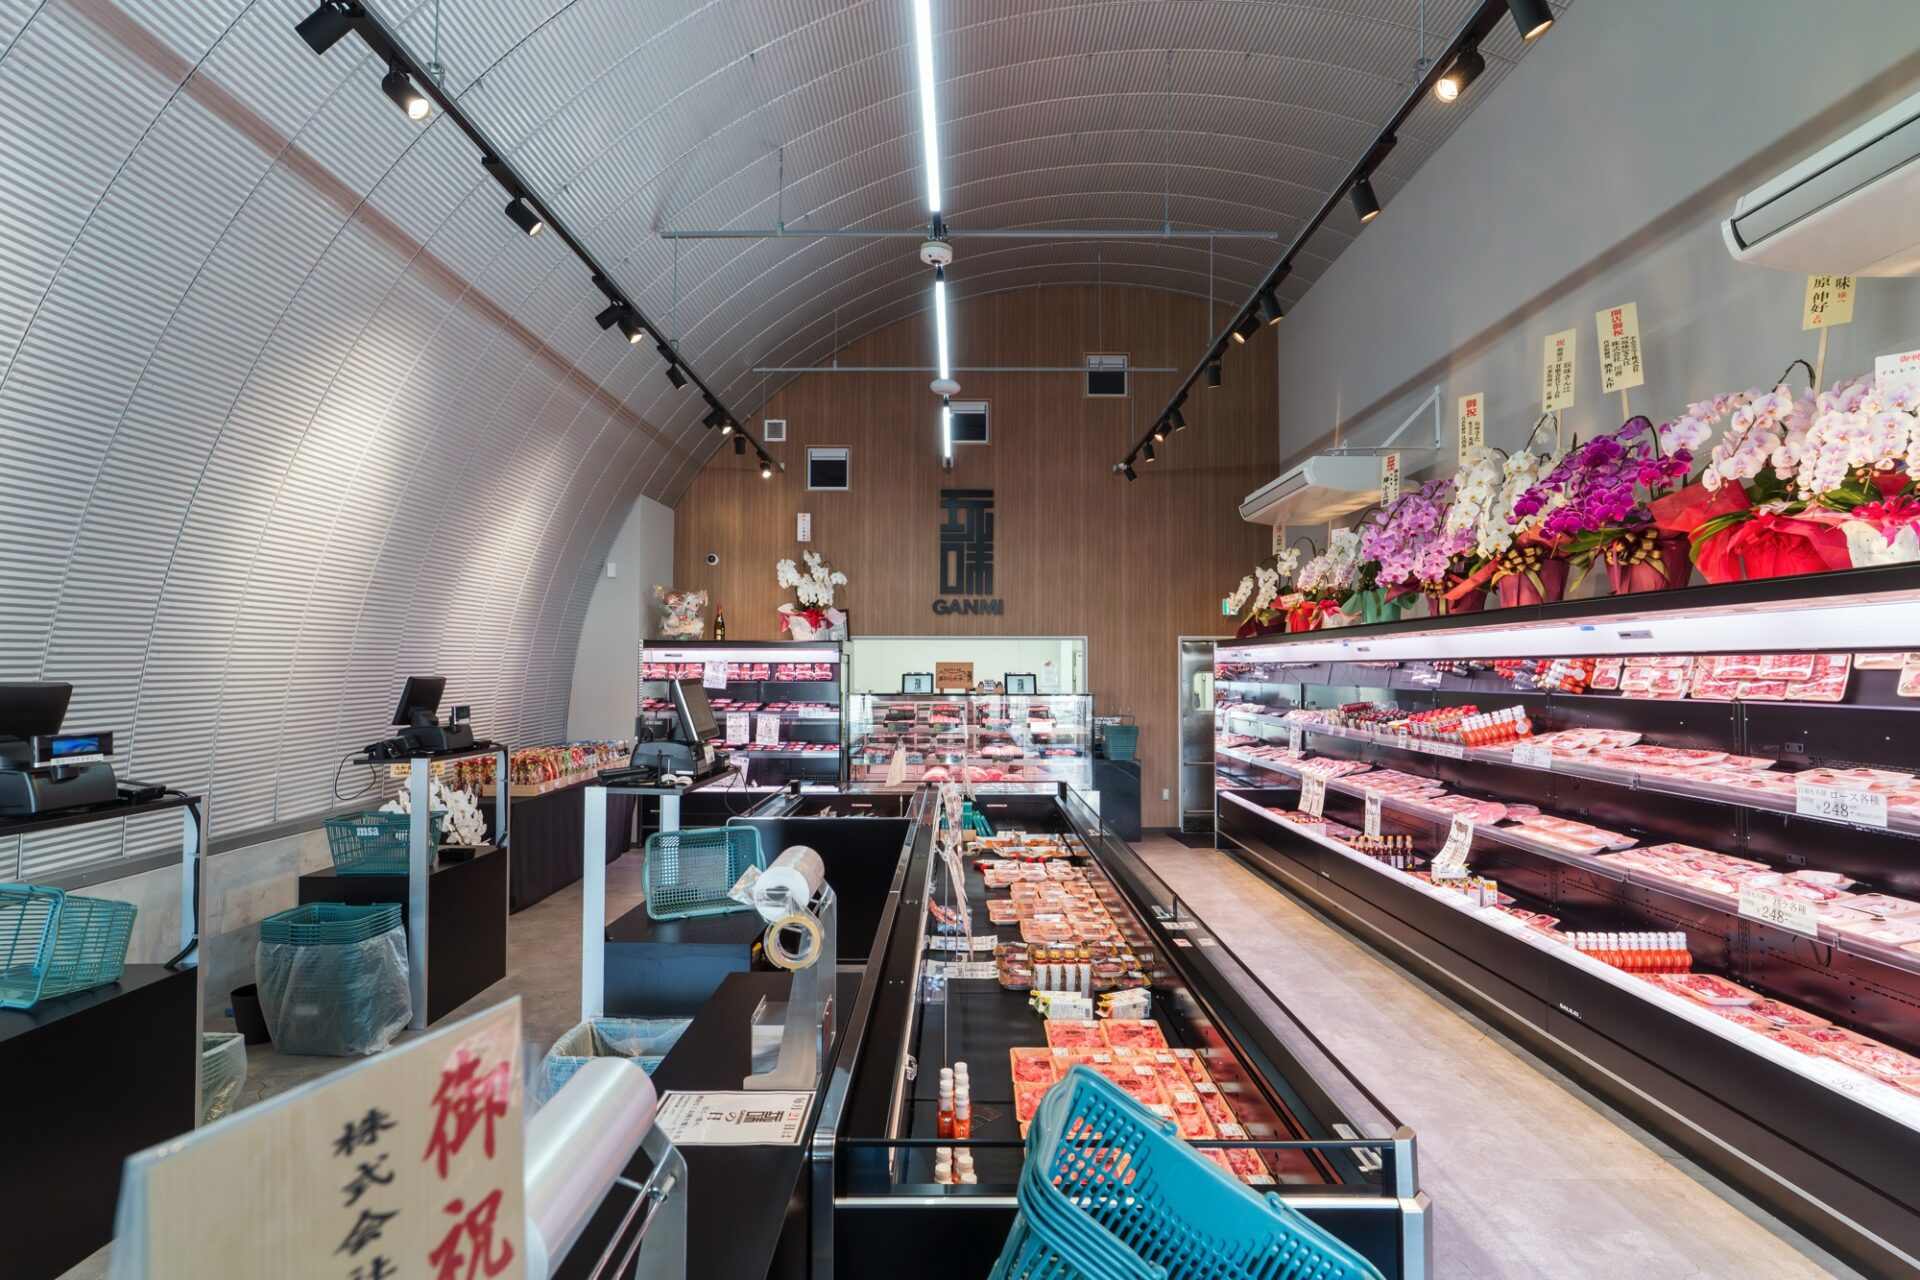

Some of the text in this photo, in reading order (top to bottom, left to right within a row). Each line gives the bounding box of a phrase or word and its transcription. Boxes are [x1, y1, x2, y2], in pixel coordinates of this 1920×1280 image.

[932, 598, 1004, 616] GANMI
[1830, 791, 1881, 807] ロース各種
[356, 826, 380, 837] msa
